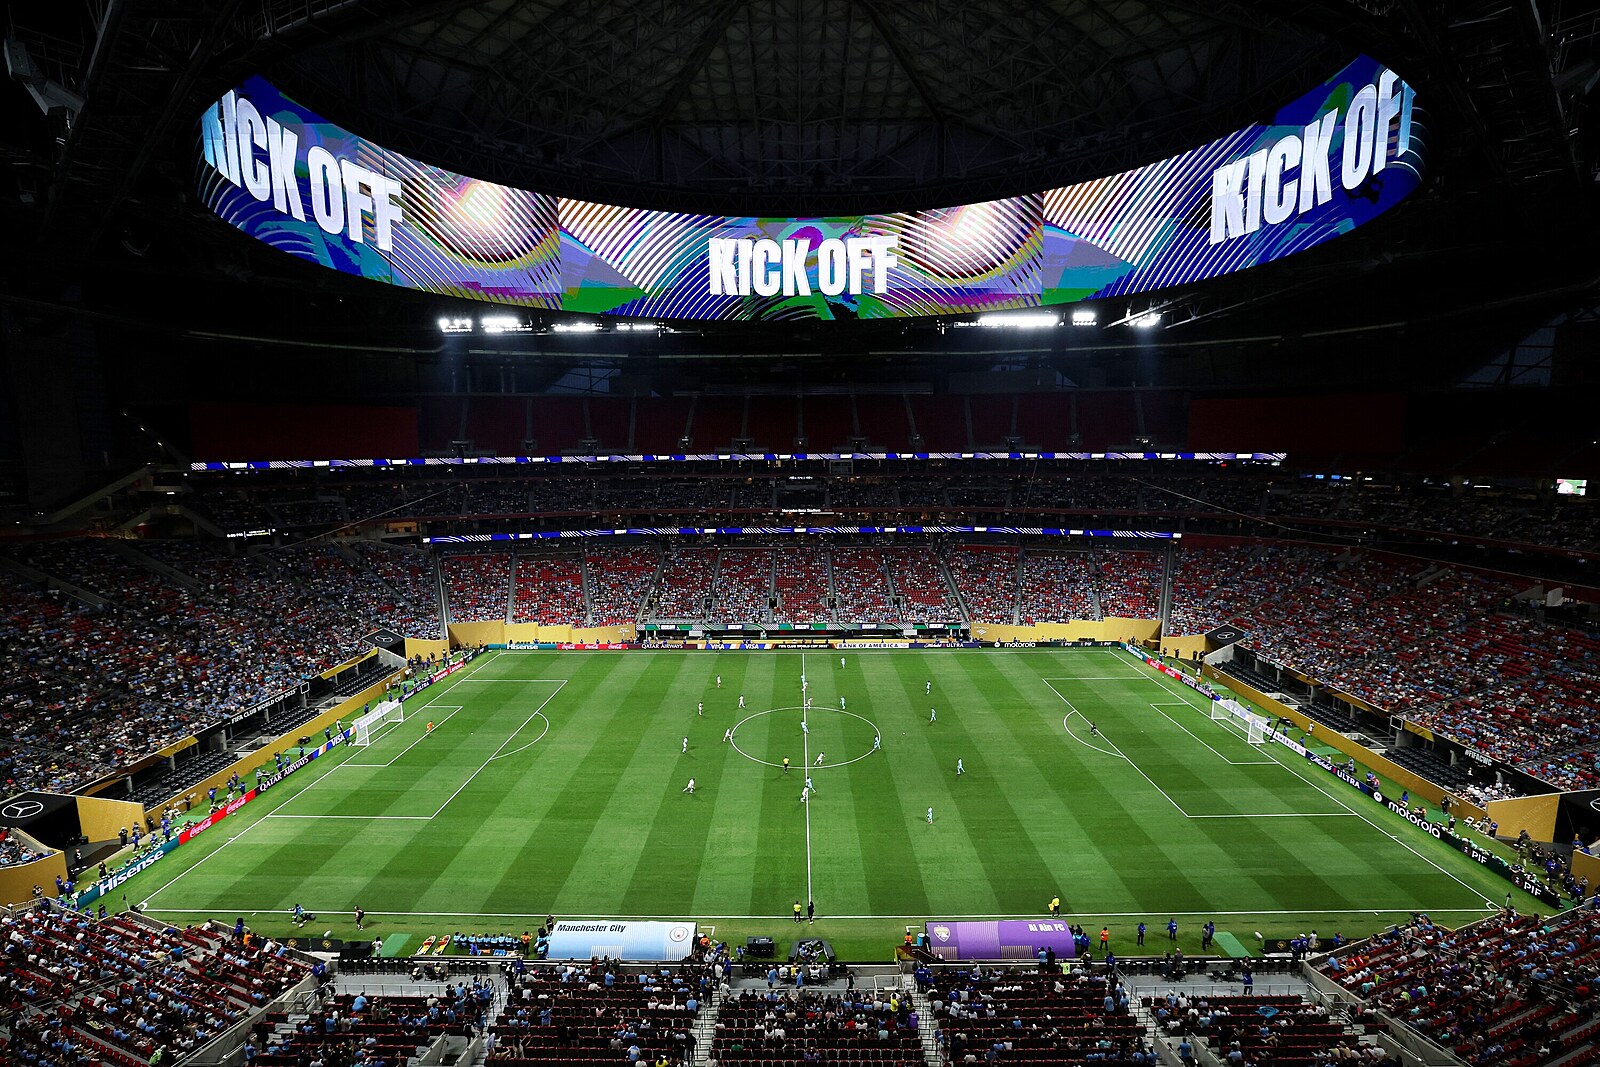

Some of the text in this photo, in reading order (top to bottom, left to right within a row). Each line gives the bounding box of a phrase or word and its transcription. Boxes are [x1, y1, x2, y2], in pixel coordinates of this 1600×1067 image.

[1210, 67, 1417, 245] KICK OFF
[201, 89, 403, 253] KICK OFF
[708, 235, 898, 296] KICK OFF
[433, 671, 448, 682] Lenovo
[449, 662, 464, 673] Lenovo
[232, 688, 296, 724] FIFA CLUB WORLD CUP 2025
[331, 733, 345, 746] VISA
[1275, 734, 1298, 749] AMERICA
[260, 757, 309, 792] QATAR AIRWAYS
[1337, 770, 1360, 789] ULTRA
[227, 796, 246, 814] Coca-Cola
[190, 817, 212, 837] Coca-Cola
[1388, 801, 1441, 839] motorola
[1472, 850, 1488, 864] PIF
[99, 850, 164, 896] Hisense
[1523, 881, 1542, 897] PIF
[609, 924, 626, 933] City
[1028, 923, 1065, 932] Al Ain FC
